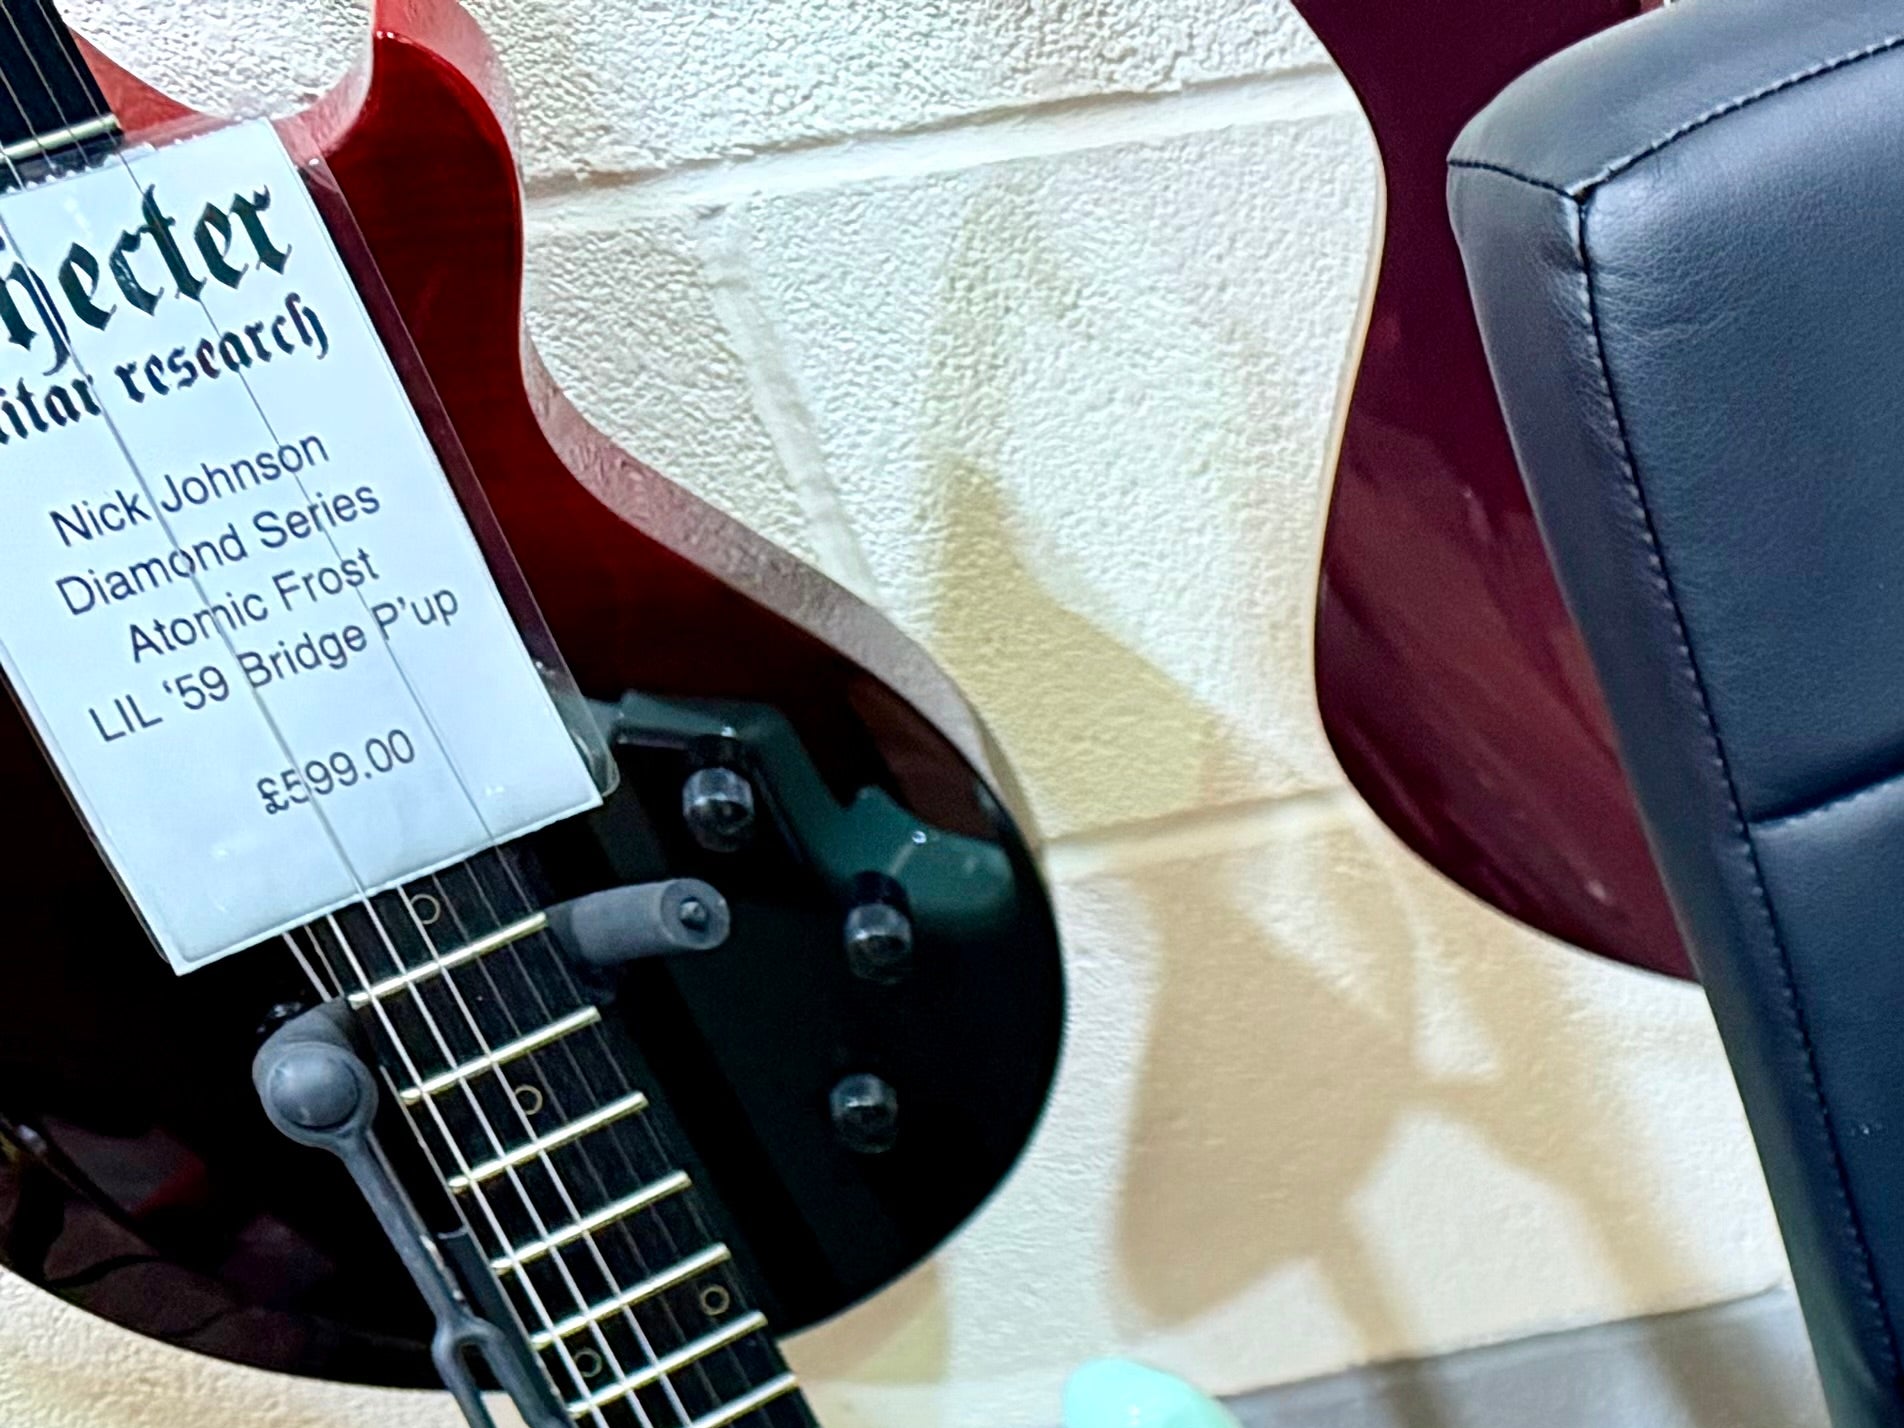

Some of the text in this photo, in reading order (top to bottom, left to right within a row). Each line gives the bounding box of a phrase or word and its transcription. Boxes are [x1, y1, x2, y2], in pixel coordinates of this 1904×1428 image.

[0, 292, 329, 445] itar research
[49, 434, 330, 547] Nick Johnson
[56, 484, 382, 616] Diamond Series
[129, 547, 380, 663] Atomic Frost
[88, 694, 163, 743] LIL
[237, 623, 368, 689] Bridge
[256, 728, 416, 815] £599.00
